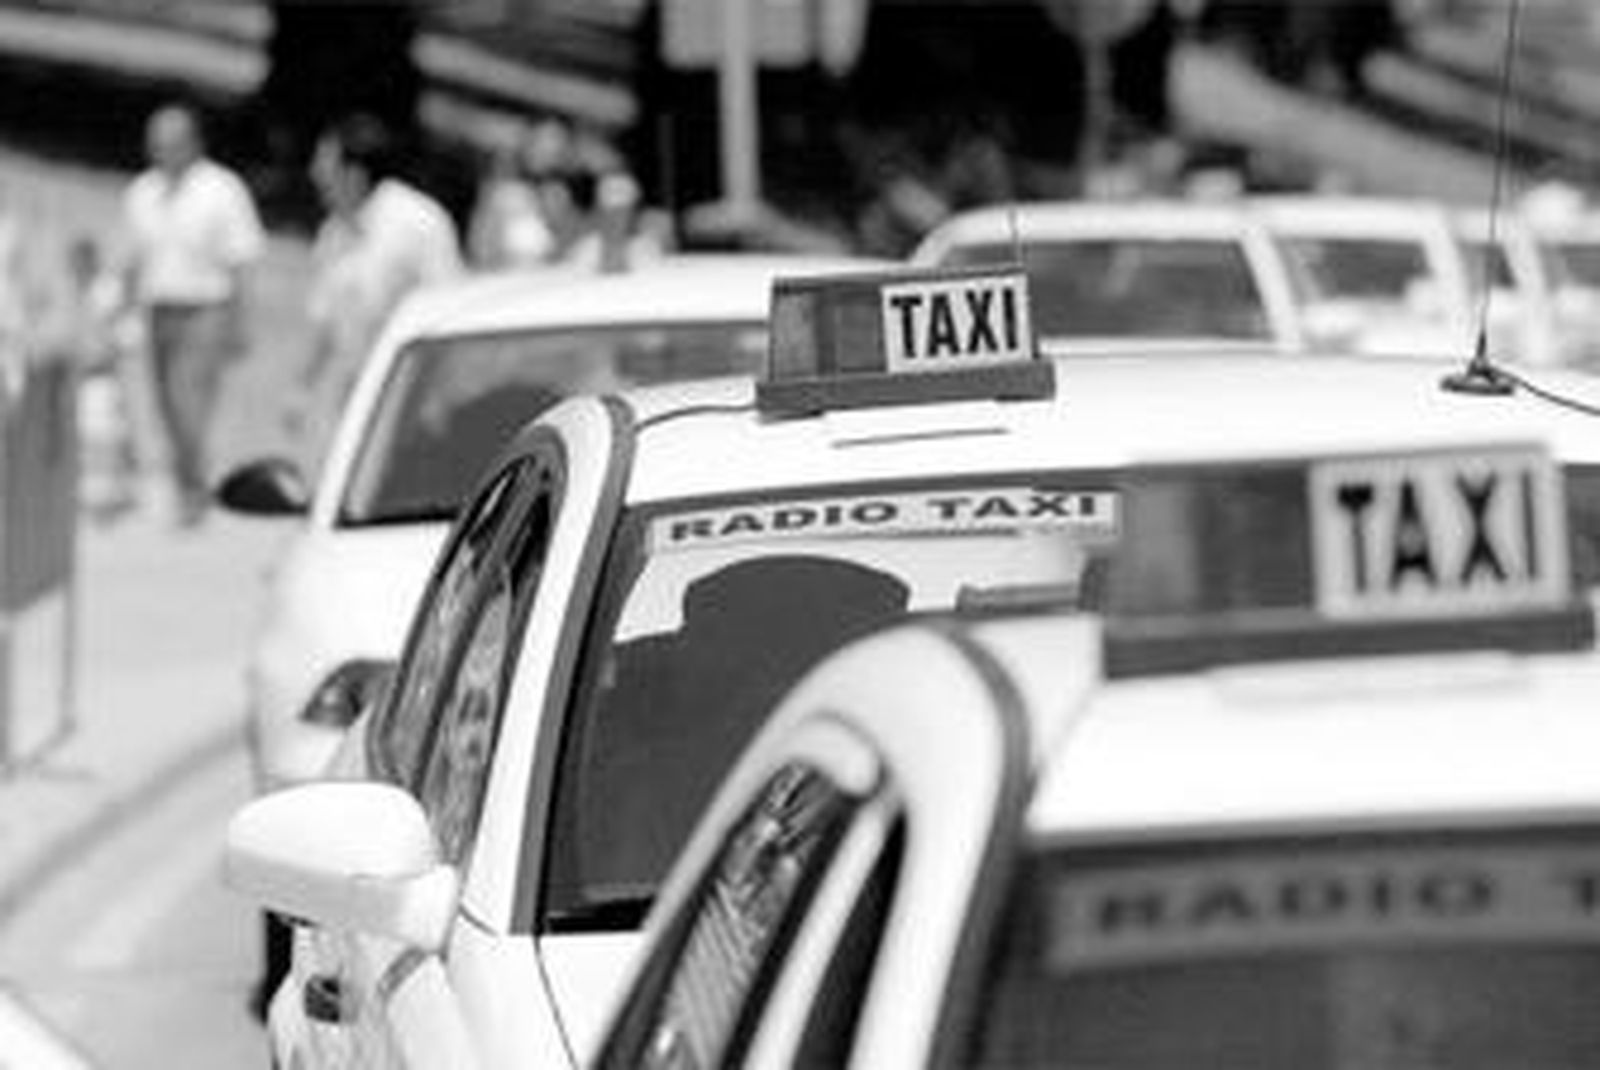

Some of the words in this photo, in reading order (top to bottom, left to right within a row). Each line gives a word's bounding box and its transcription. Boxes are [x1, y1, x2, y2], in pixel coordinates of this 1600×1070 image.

[890, 288, 1018, 358] TAXI
[670, 501, 898, 541] RADIO
[929, 493, 1097, 521] TAXI
[1336, 468, 1536, 592] TAXI
